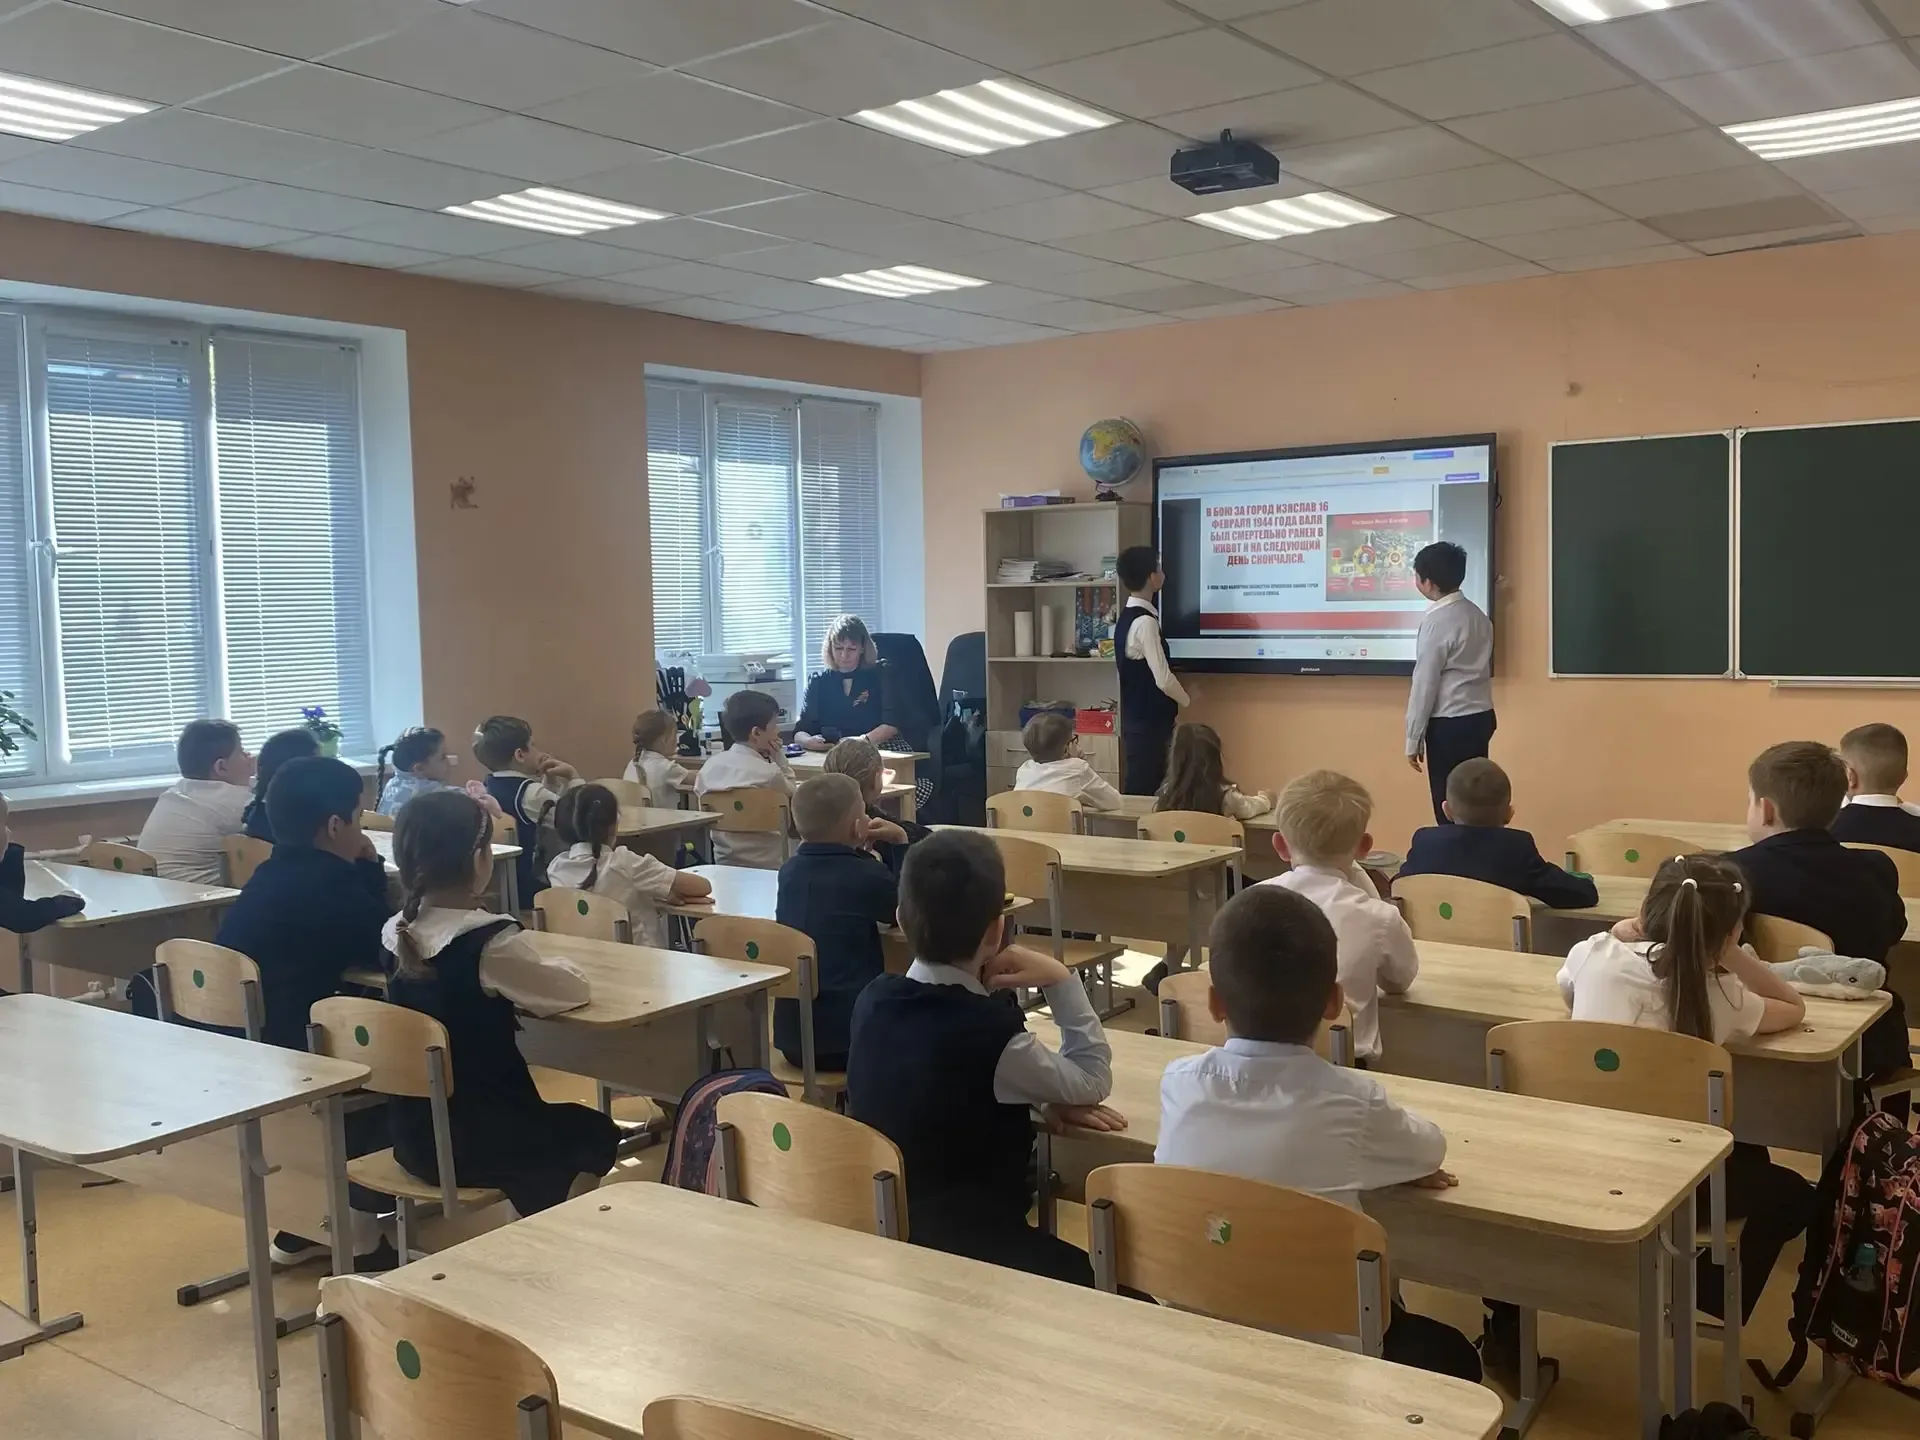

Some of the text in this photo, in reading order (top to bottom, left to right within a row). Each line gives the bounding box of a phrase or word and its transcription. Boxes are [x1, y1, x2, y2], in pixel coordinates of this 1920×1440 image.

[1206, 508, 1212, 516] В
[1214, 506, 1232, 516] БОЮ
[1234, 506, 1246, 515] ЗА
[1246, 504, 1274, 515] ГОРОД
[1319, 502, 1328, 511] 16
[1212, 514, 1322, 528] ФЕВРАЛЯ 1944 ГОДА ВАЛЯ
[1210, 528, 1324, 541] БЫЛ СМЕРТЕЛЬНО РАНЕН В
[1213, 538, 1320, 553] ЖИВОТ И НА СЛЕДУЮЩИЙ
[1227, 556, 1250, 567] ДЕНЬ
